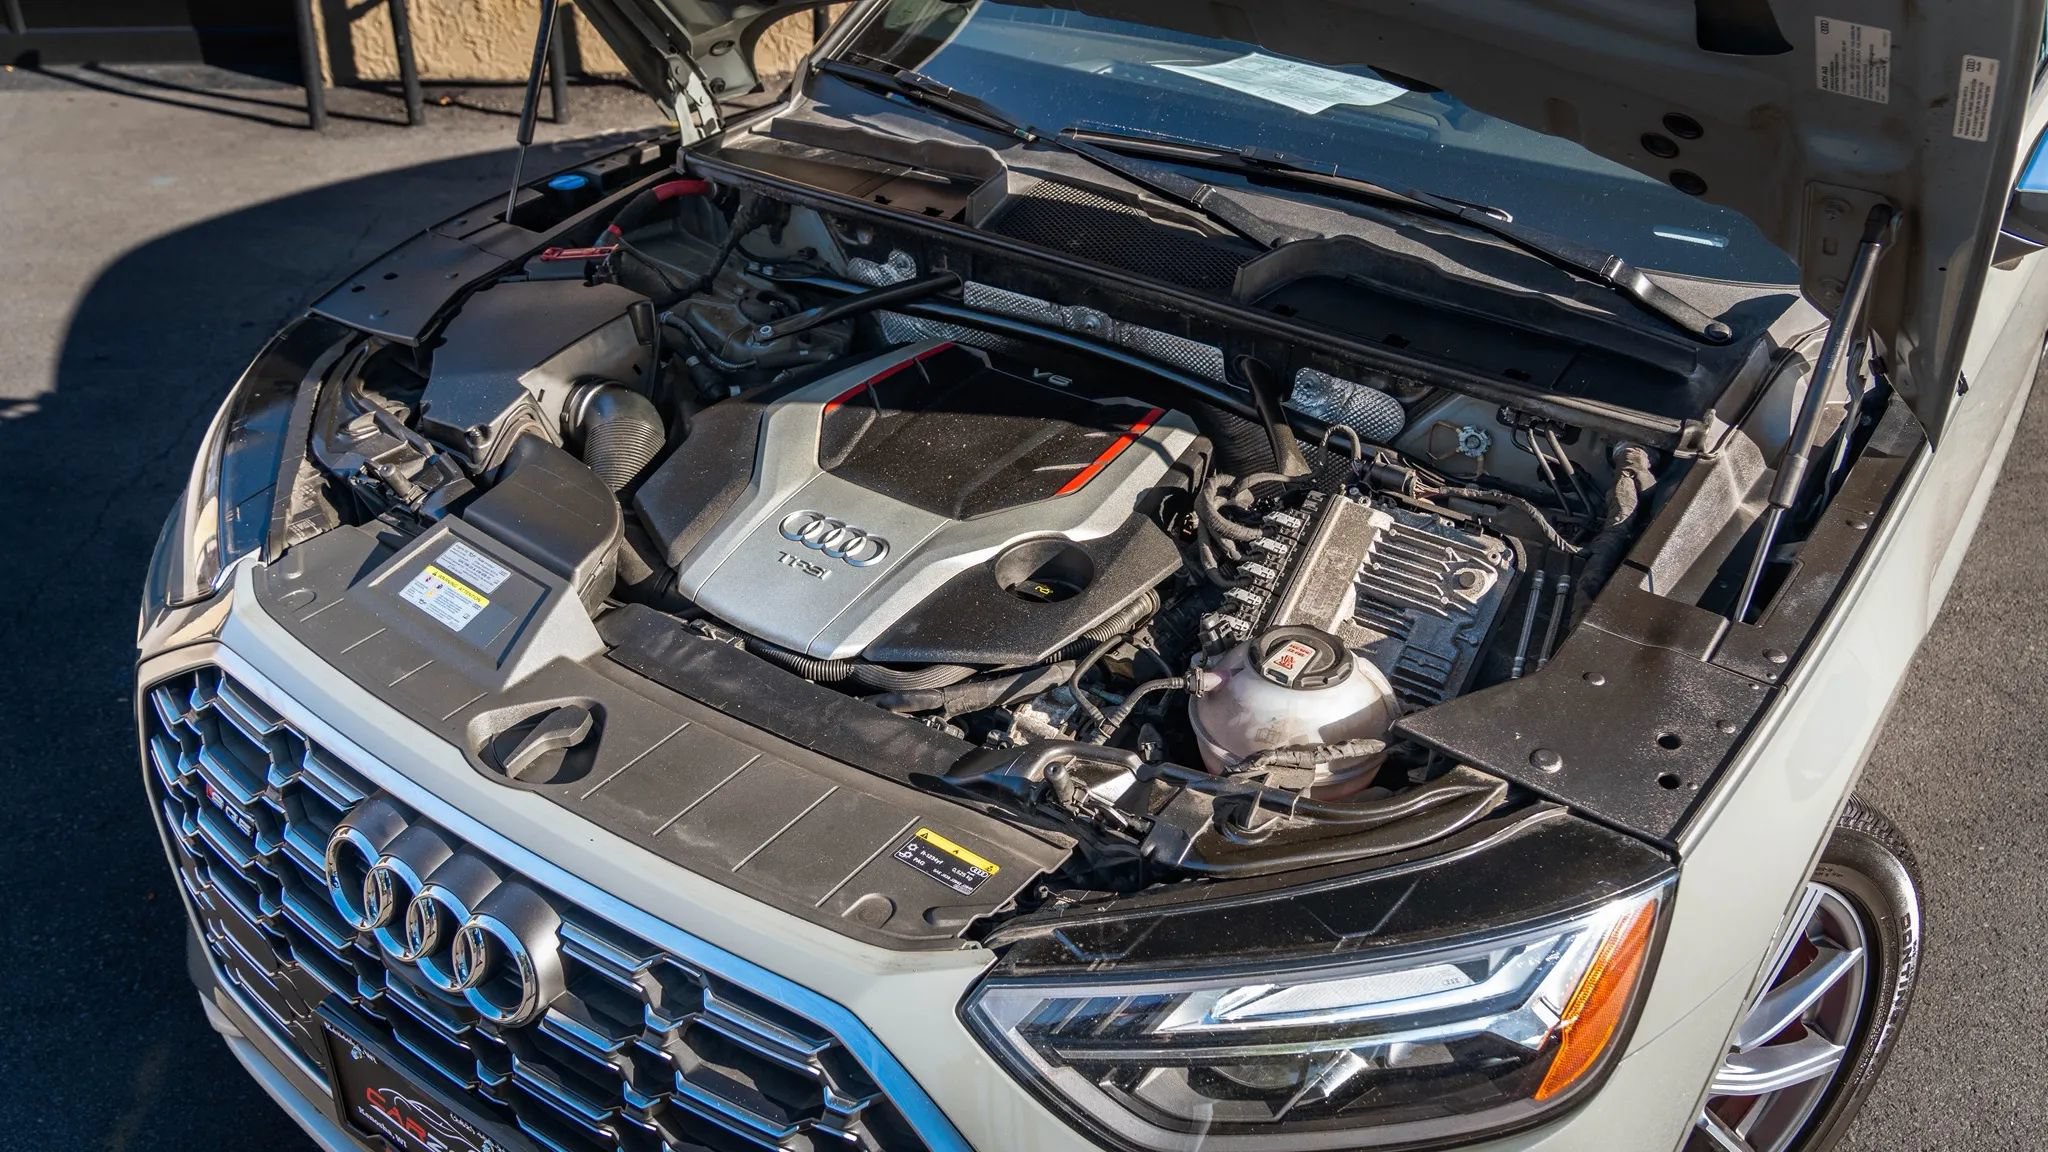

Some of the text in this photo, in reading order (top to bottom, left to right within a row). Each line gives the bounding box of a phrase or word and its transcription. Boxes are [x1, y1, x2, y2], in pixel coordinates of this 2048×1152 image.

[1033, 367, 1073, 387] V6
[778, 550, 833, 581] TFSI
[437, 572, 482, 603] WARNING ATTENTION
[912, 857, 926, 866] PAG
[920, 850, 944, 865] R-1234yf
[366, 1087, 456, 1152] CARZ
